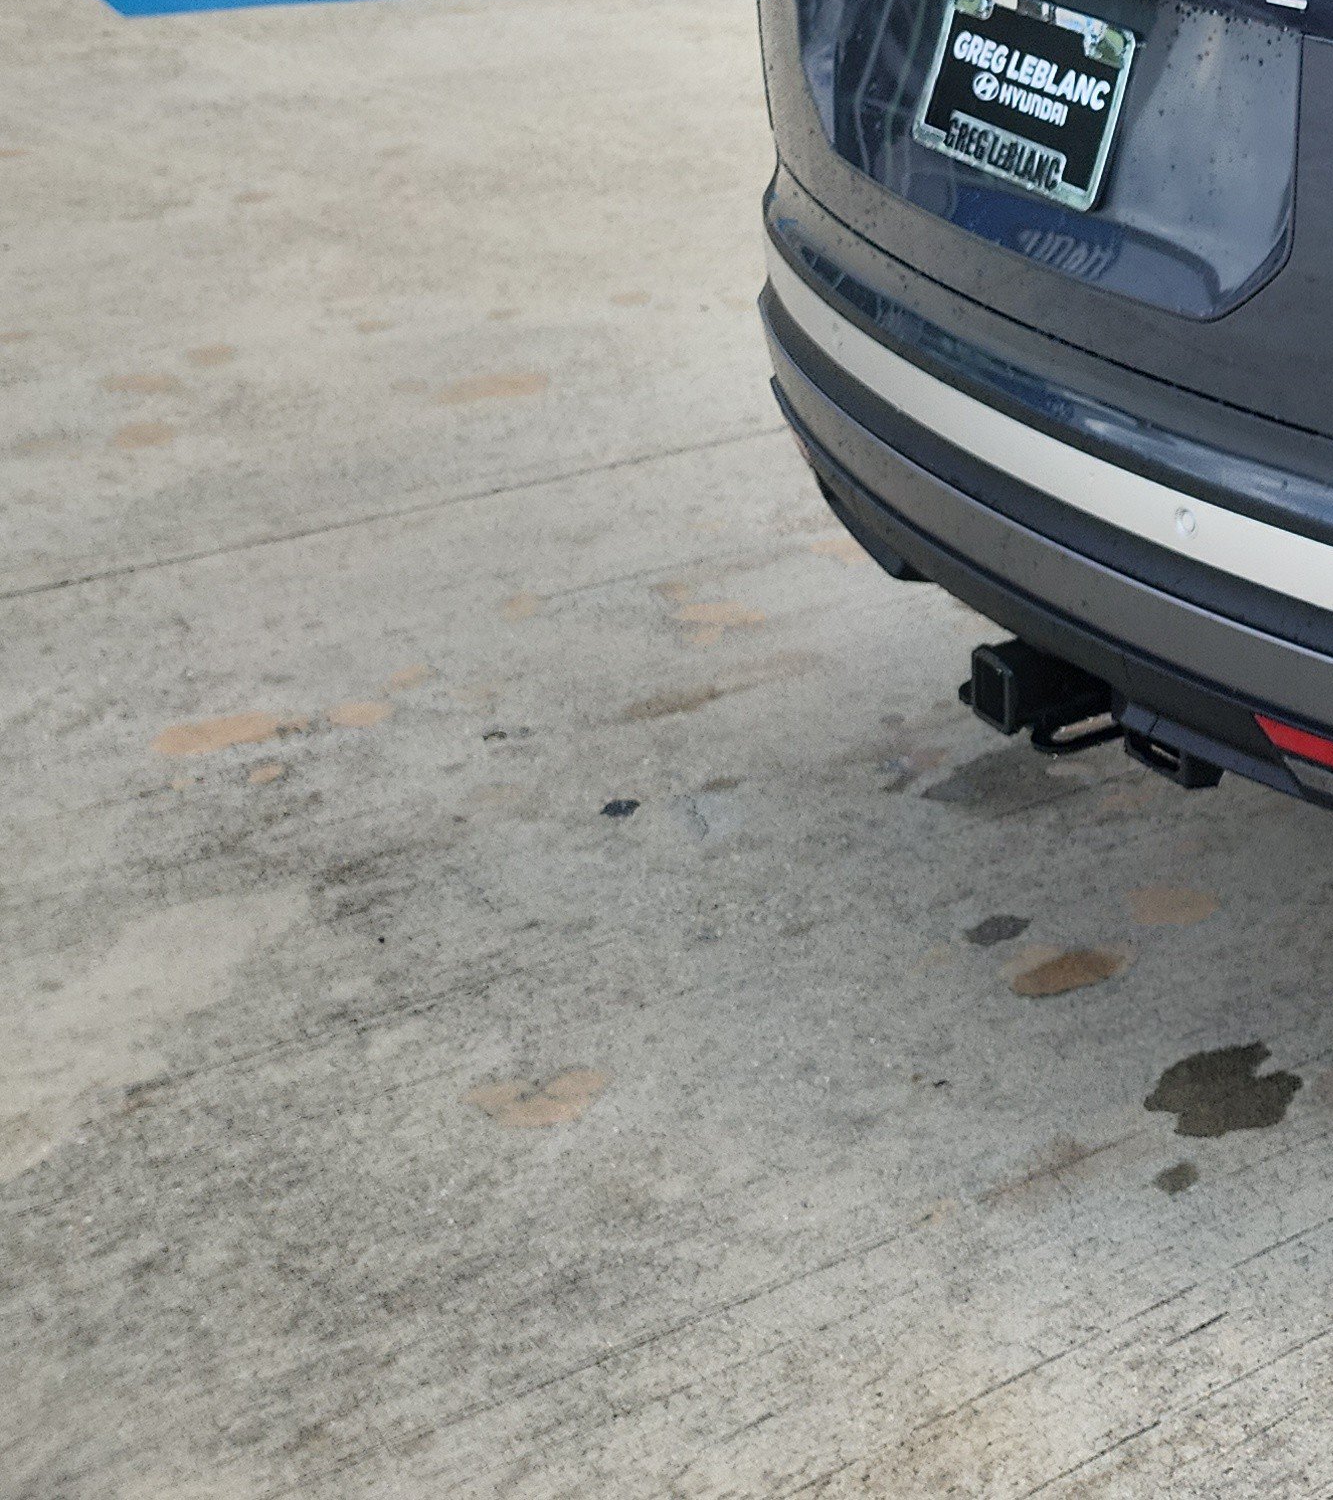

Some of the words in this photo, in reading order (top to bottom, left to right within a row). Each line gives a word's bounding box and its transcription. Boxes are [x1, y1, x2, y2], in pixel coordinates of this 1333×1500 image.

[953, 30, 1010, 74] GREG
[1006, 50, 1111, 111] LEBLANC
[998, 82, 1069, 127] HYUNDAI
[943, 116, 990, 161] GREG
